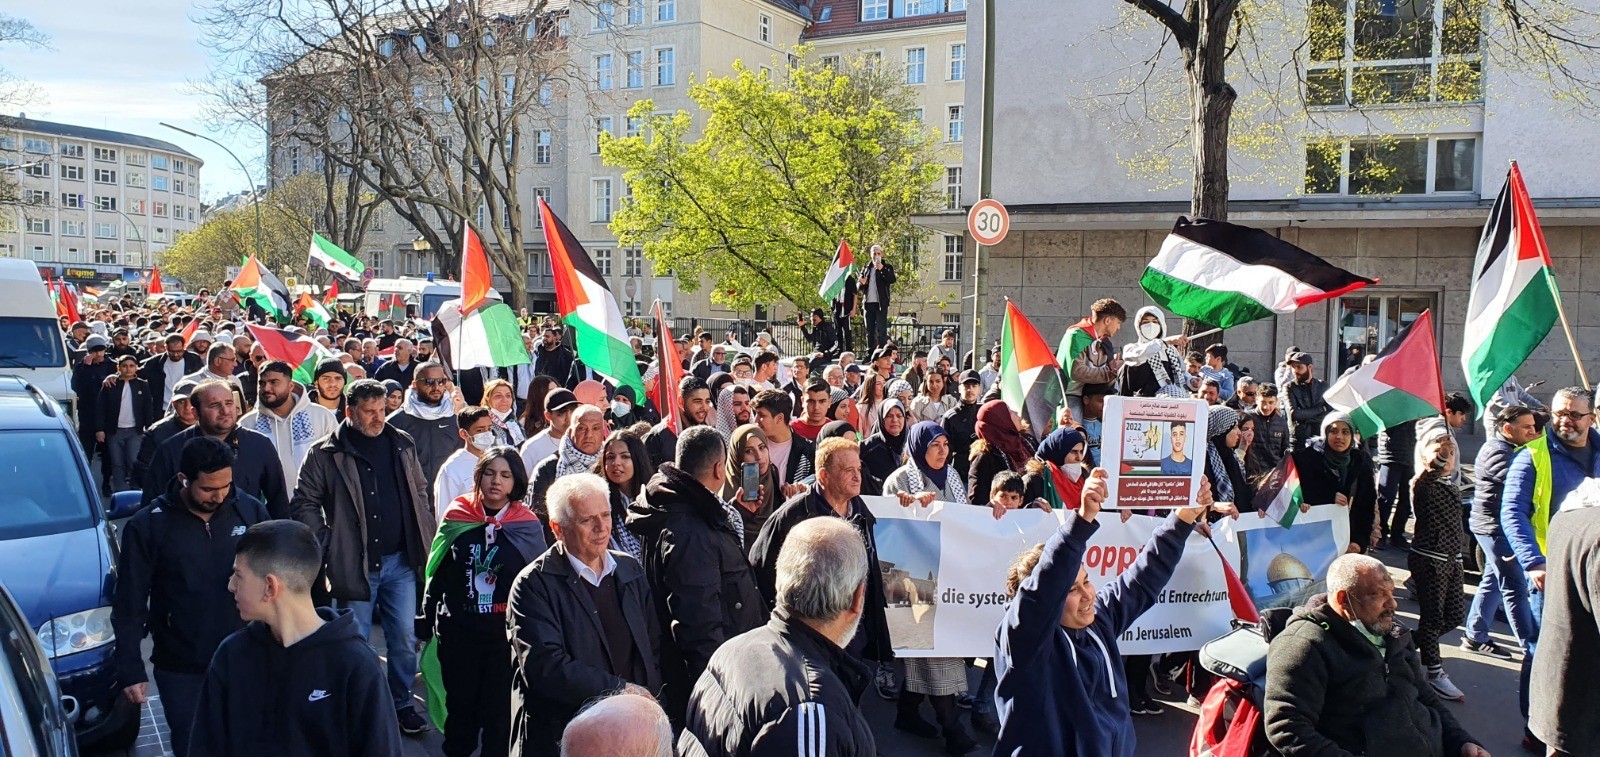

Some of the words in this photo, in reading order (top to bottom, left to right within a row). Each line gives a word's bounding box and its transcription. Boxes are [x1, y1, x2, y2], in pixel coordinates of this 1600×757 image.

[978, 211, 1000, 233] 30
[1126, 422, 1142, 431] 2022
[942, 588, 965, 604] die
[968, 591, 1011, 608] syste
[1136, 624, 1192, 641] Jerusalem
